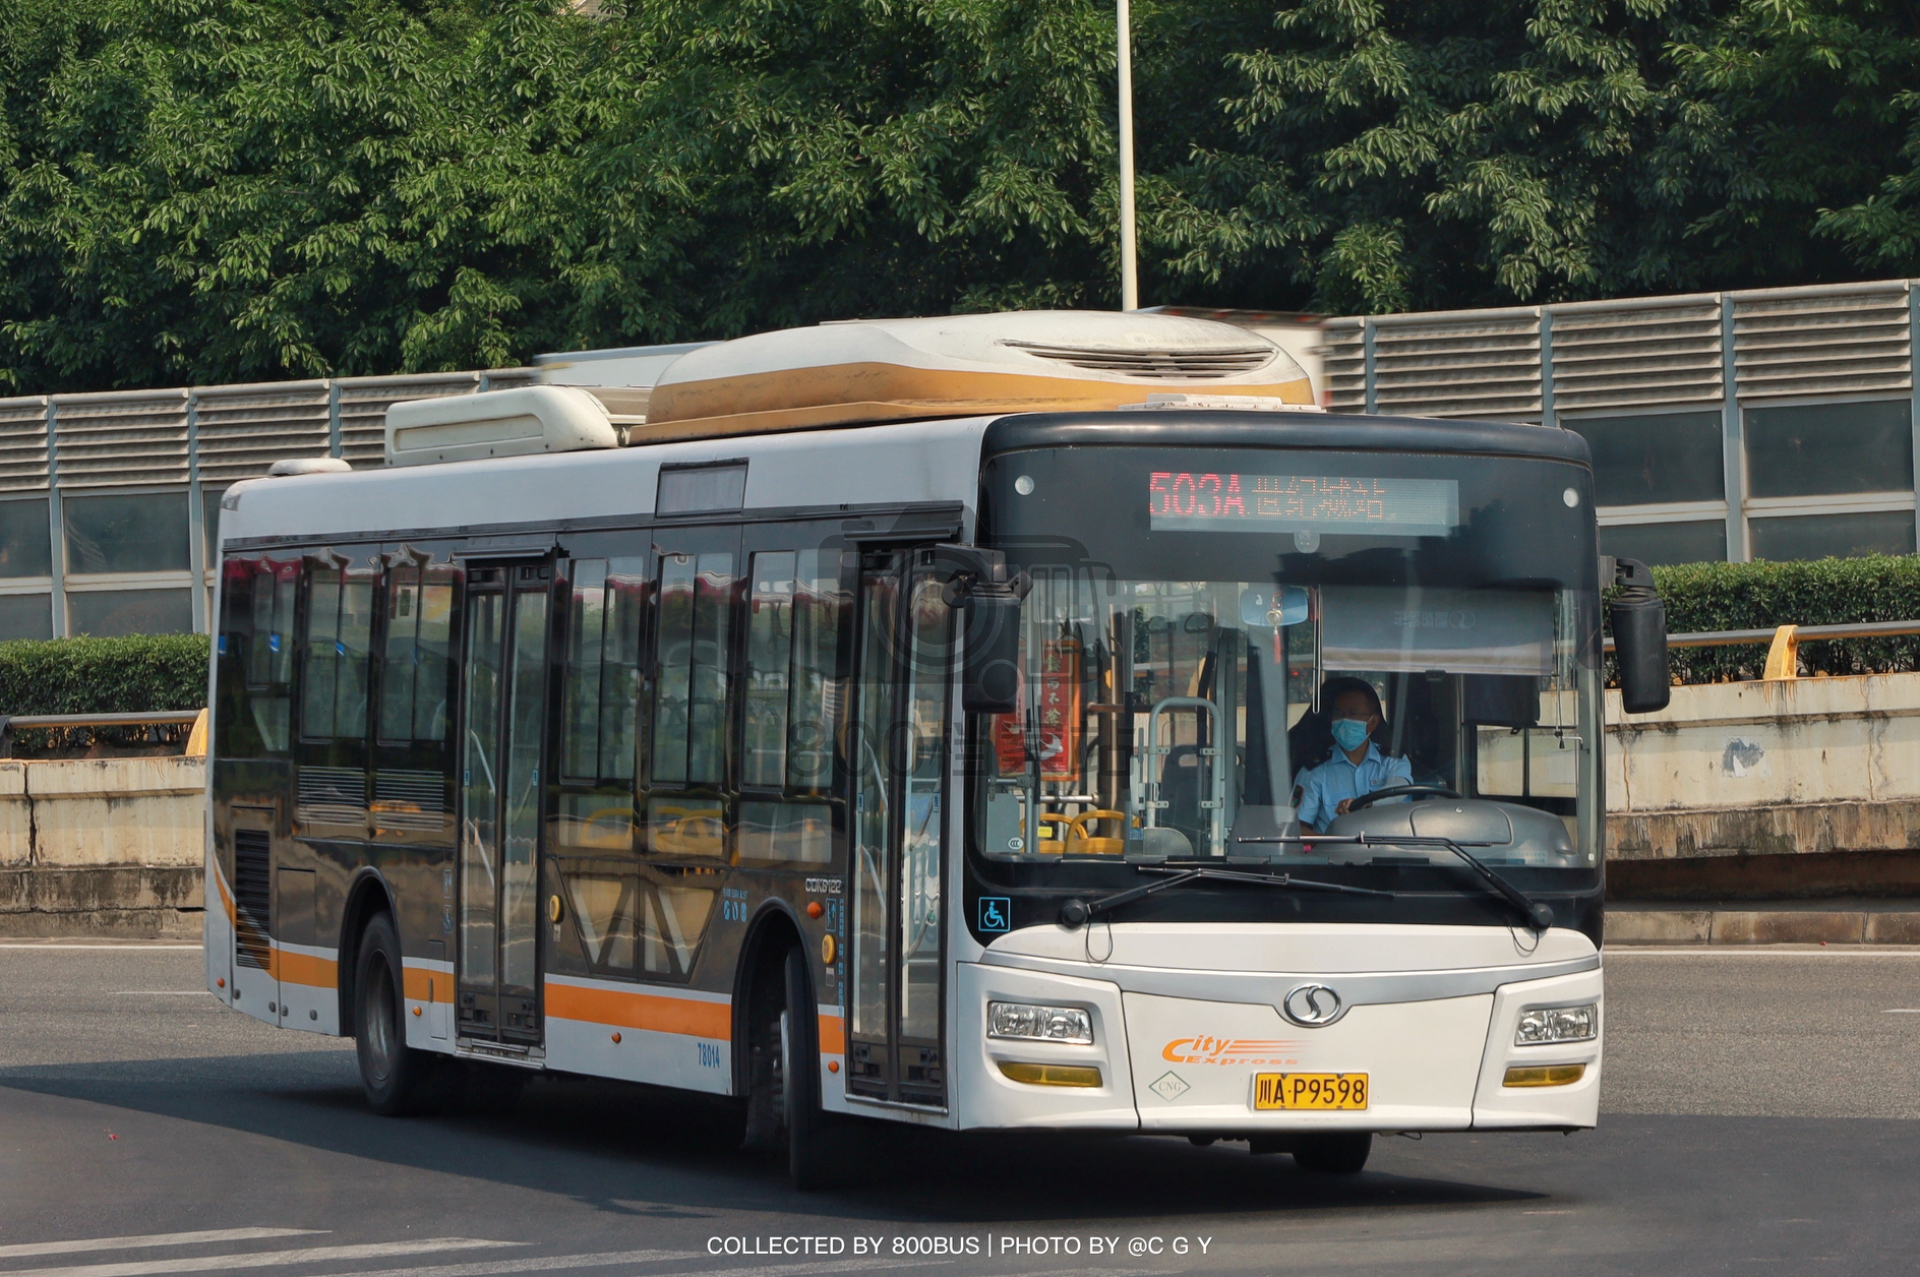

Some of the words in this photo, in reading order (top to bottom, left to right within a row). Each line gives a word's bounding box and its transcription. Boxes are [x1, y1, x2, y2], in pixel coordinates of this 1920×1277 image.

[1149, 472, 1244, 516] 503A
[1161, 1034, 1232, 1064] City
[1158, 1080, 1182, 1094] CNG
